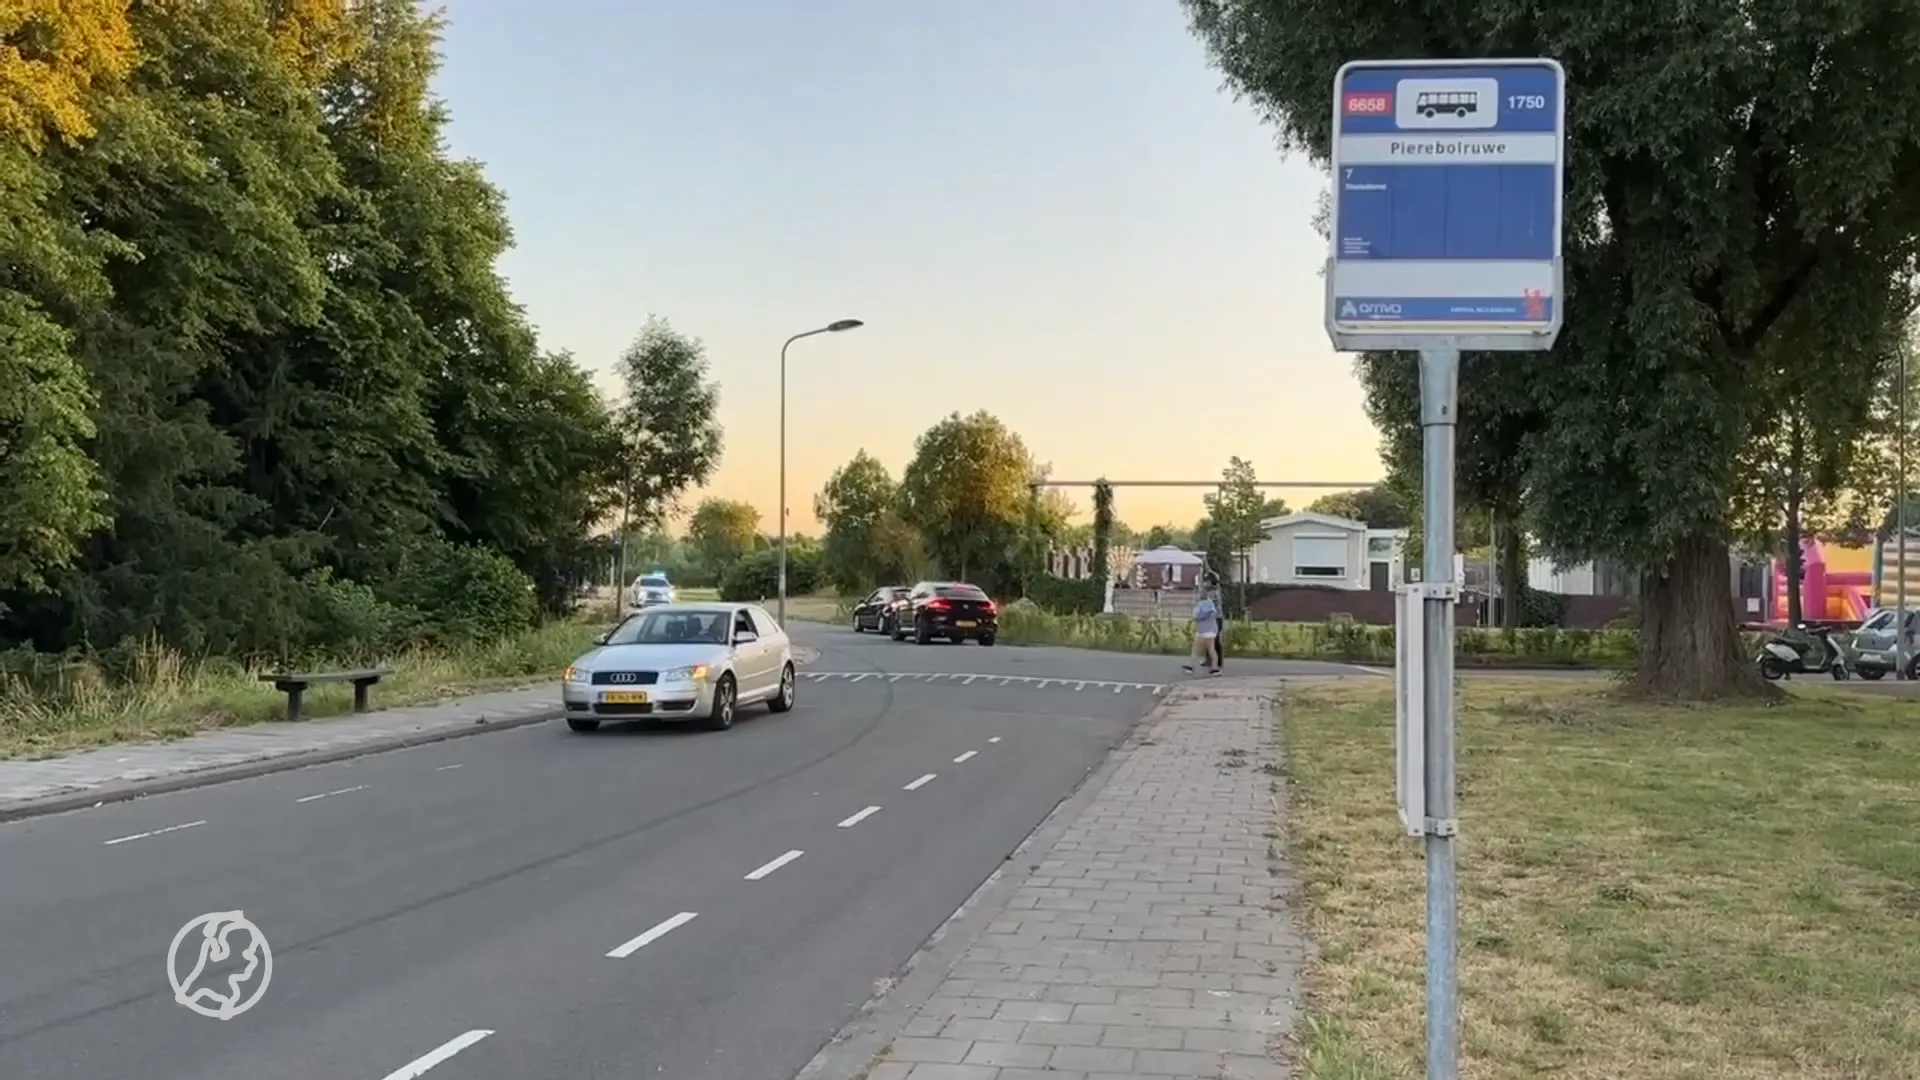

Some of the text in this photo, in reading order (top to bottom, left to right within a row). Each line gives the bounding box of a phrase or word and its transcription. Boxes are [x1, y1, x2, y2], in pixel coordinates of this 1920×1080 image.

[1348, 98, 1386, 112] 6658
[1507, 96, 1545, 109] 1750
[1344, 168, 1353, 179] 7
